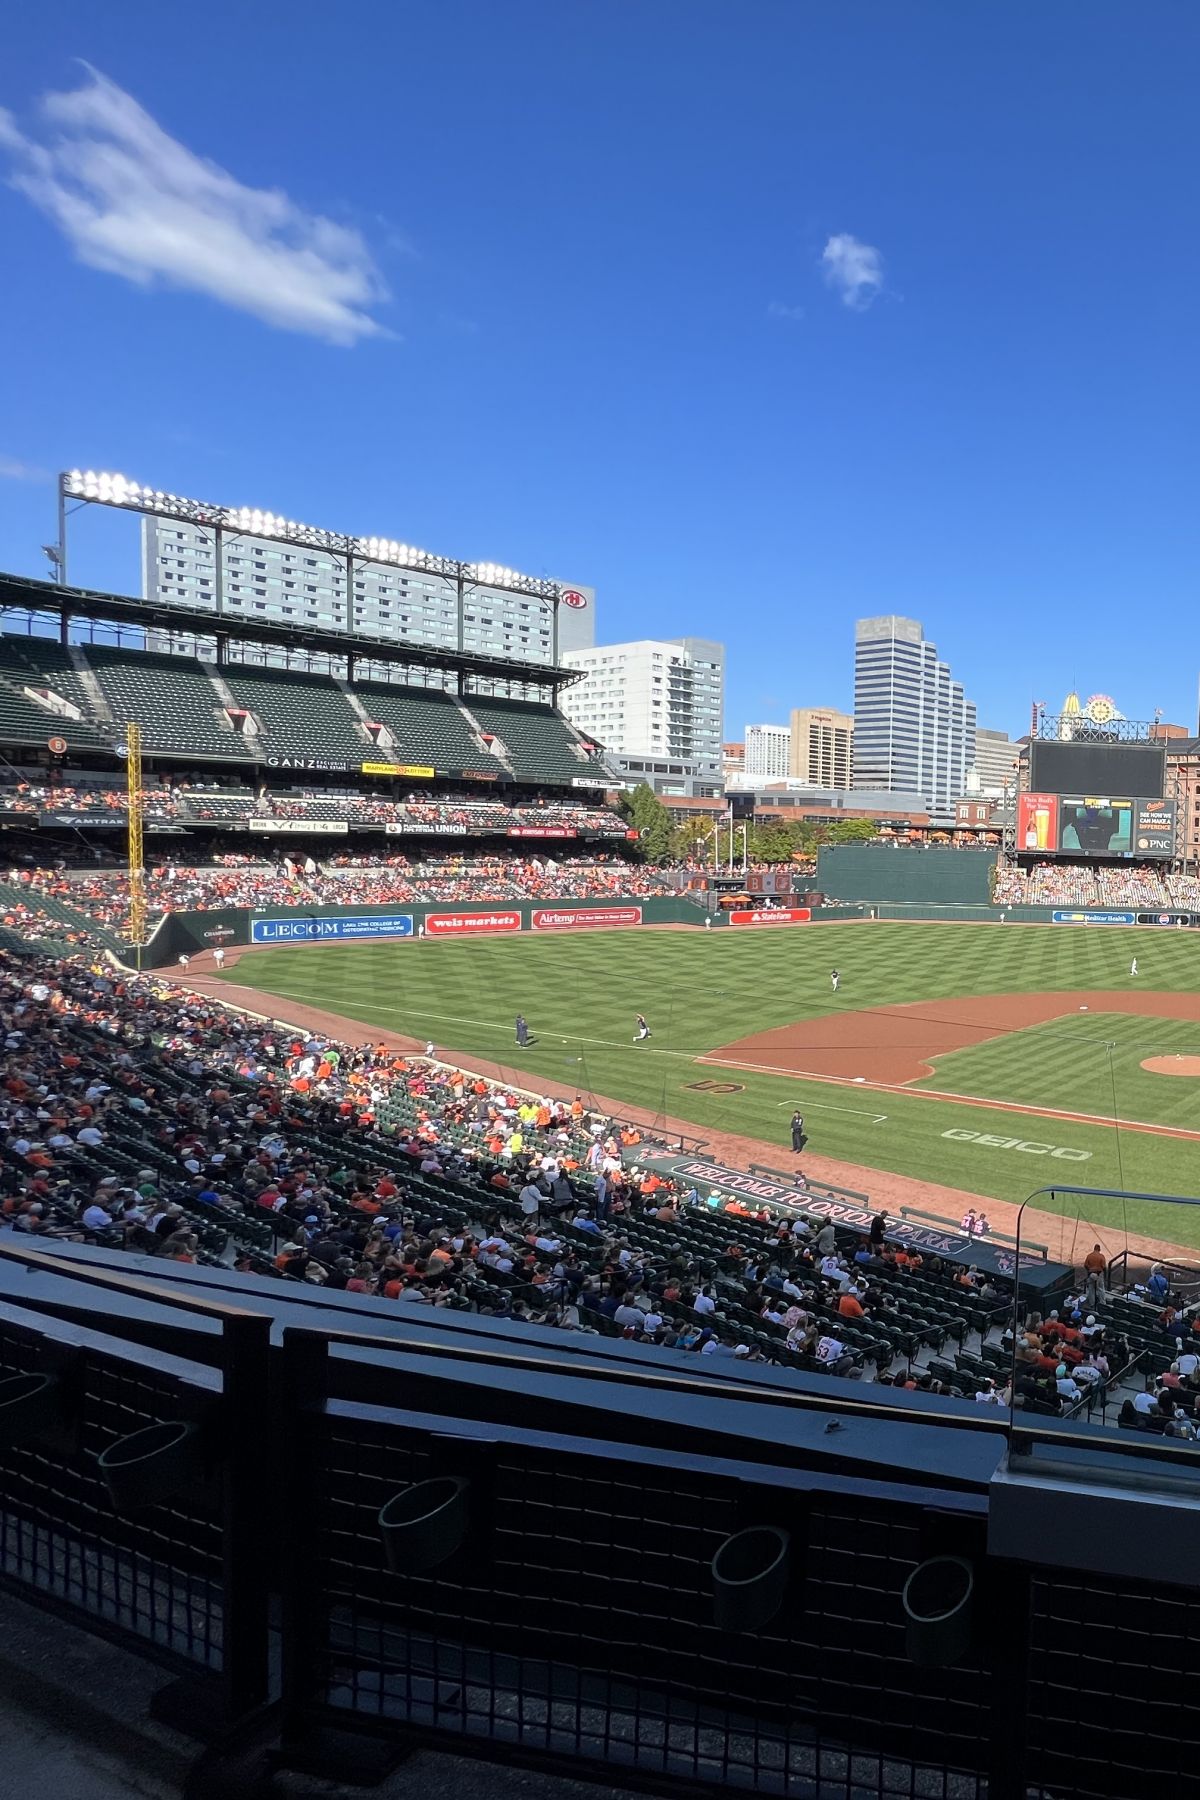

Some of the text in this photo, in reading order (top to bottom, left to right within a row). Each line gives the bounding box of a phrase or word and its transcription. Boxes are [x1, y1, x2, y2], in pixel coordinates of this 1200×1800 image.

[267, 757, 315, 769] GANZ
[435, 824, 467, 835] UNION
[1149, 839, 1171, 849] PNC
[433, 916, 515, 928] weis markets
[540, 912, 575, 925] Airtemp
[940, 1128, 1093, 1161] GEICO
[683, 1163, 962, 1252] WELCOME TO ORIOL PARK
